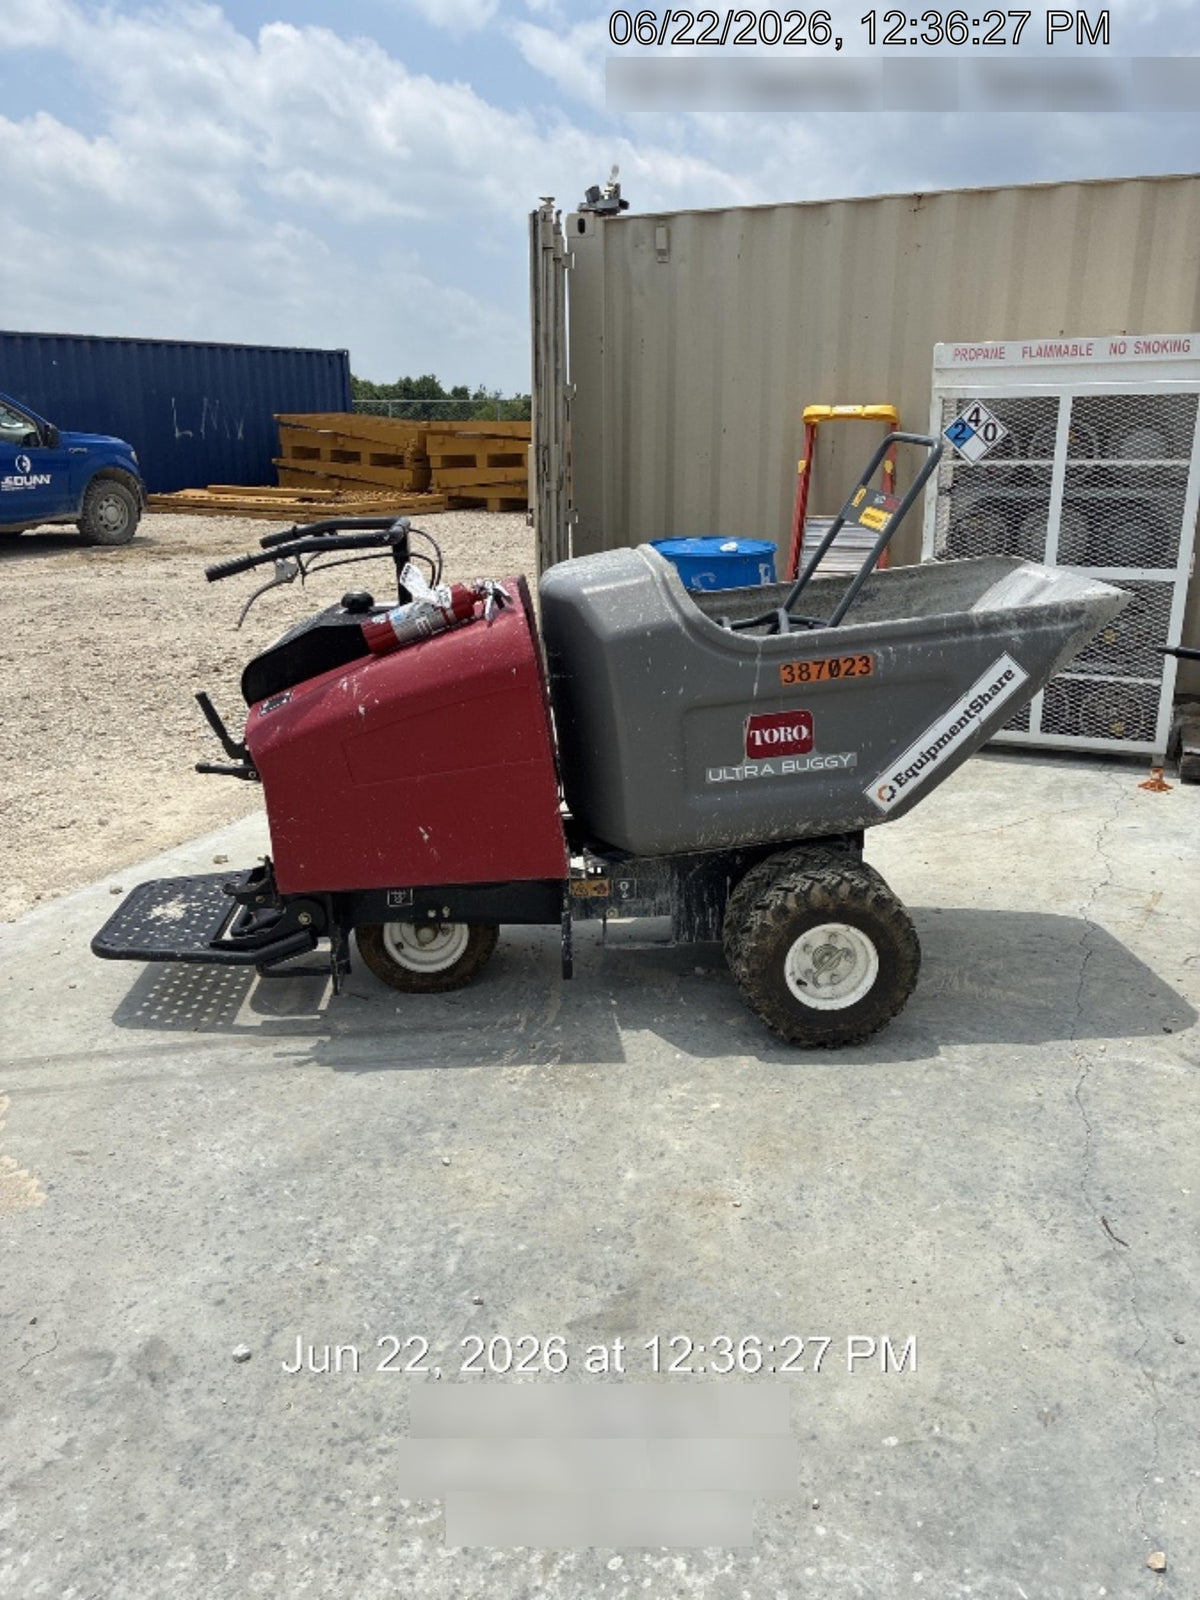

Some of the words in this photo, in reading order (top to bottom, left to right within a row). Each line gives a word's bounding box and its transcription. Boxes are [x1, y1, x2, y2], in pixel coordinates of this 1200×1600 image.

[953, 346, 1006, 362] PROPANE
[1021, 343, 1094, 359] FLAMMABLE
[1109, 341, 1127, 356] NO
[1134, 339, 1191, 355] SMOKING
[968, 407, 981, 427] 4
[953, 422, 966, 440] 2
[984, 423, 997, 442] 0
[782, 655, 872, 684] 387023
[750, 724, 810, 746] TORO
[892, 668, 1016, 788] EquipmentShare
[708, 763, 775, 782] ULTRA
[781, 753, 852, 774] BUGGY
